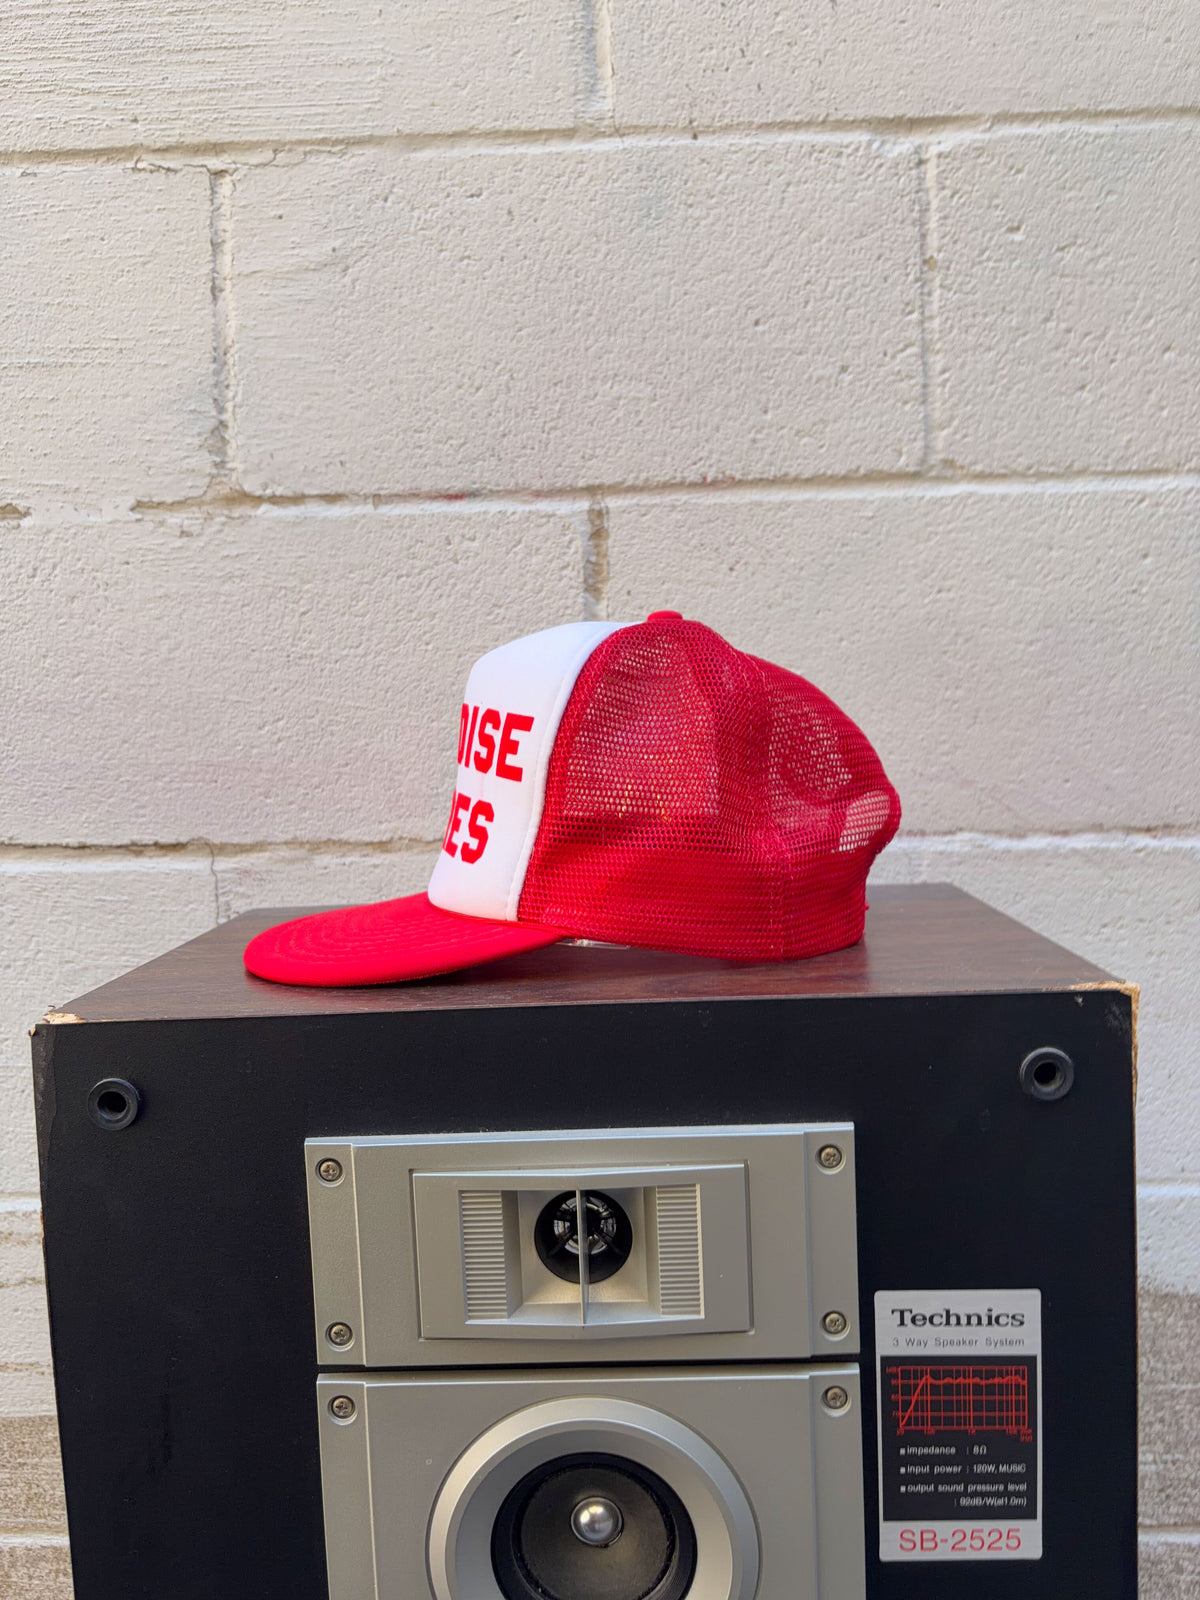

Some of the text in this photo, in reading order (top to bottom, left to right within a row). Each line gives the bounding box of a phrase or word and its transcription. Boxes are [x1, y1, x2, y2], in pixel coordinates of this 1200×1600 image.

[442, 788, 495, 864] ES
[891, 1307, 1025, 1328] Technics
[892, 1336, 1025, 1349] 3 Way Speaker System
[907, 1445, 956, 1456] impedance
[907, 1464, 930, 1475] input
[934, 1465, 962, 1475] power
[907, 1481, 1027, 1494] output sound pressure level
[899, 1527, 1022, 1553] SB-2525
